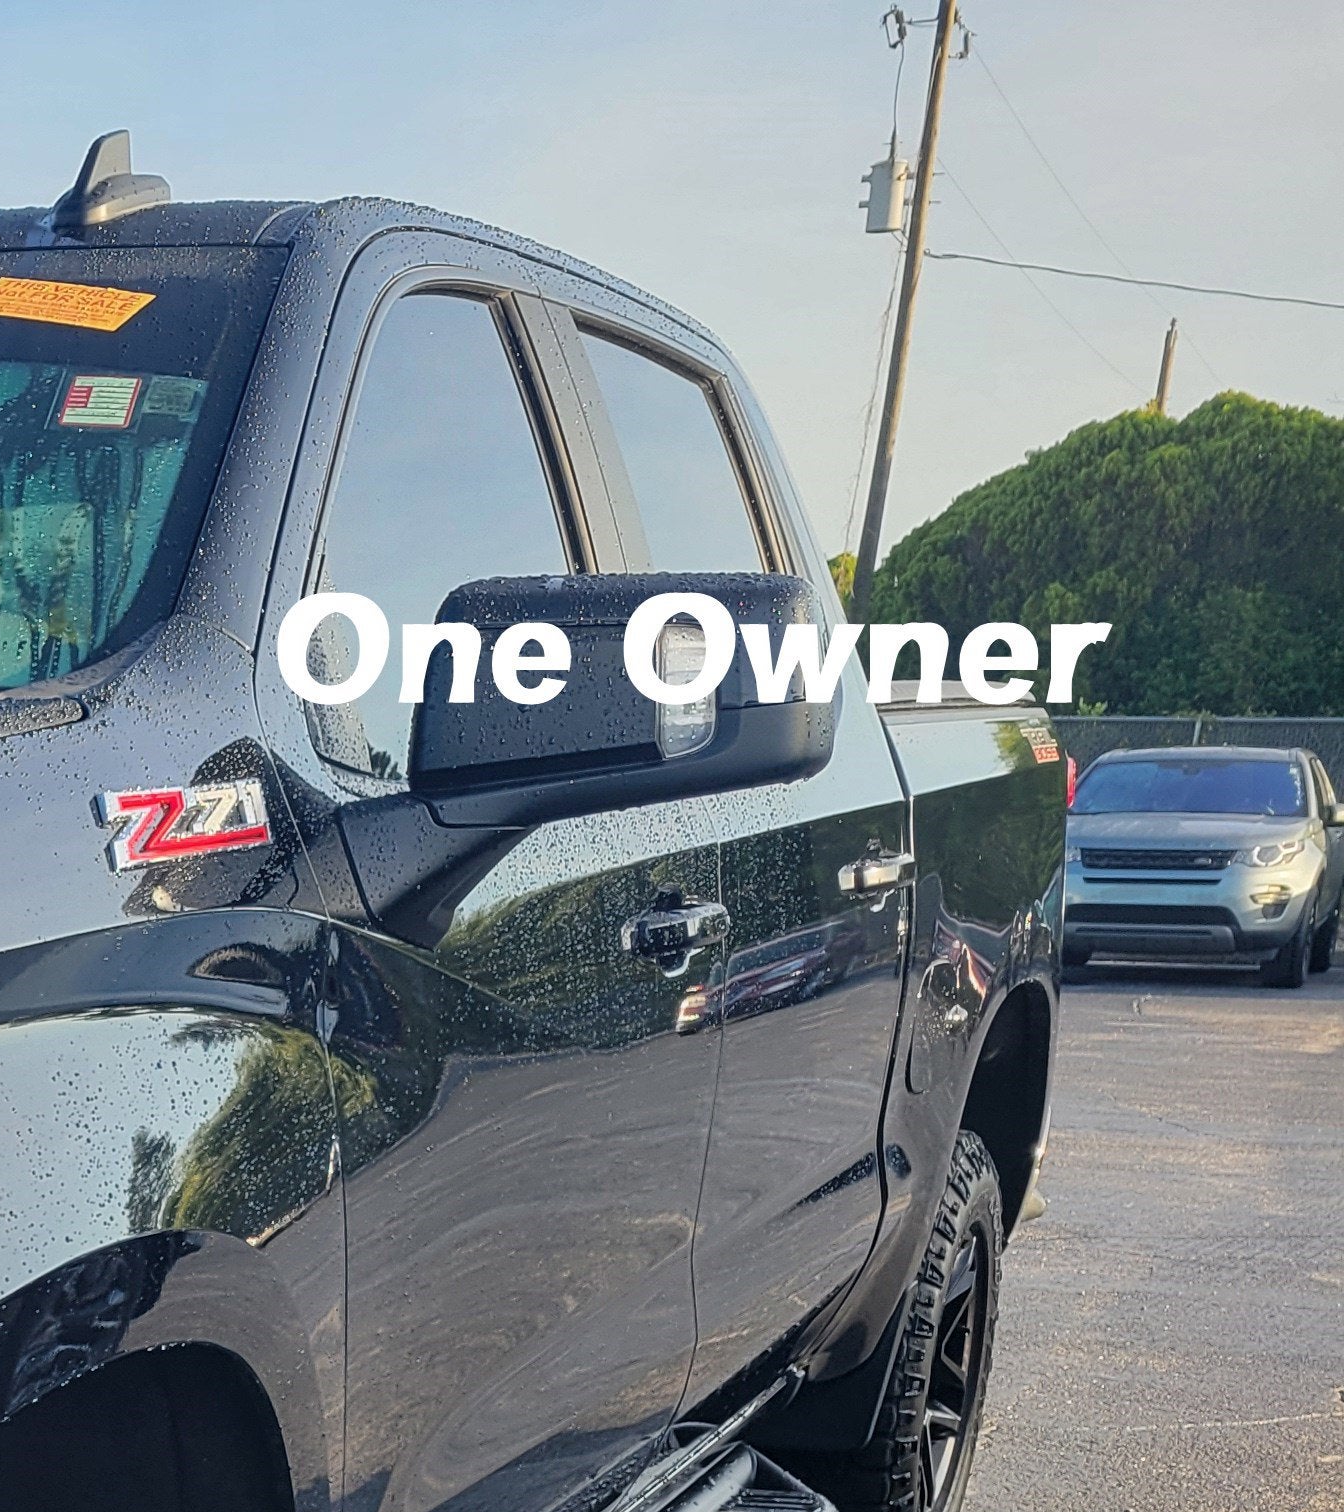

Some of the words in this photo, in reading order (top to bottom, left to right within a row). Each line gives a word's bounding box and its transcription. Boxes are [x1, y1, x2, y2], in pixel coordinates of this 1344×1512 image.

[2, 280, 51, 292] THIS
[53, 284, 143, 301] VEHICLE
[29, 292, 75, 303] FOR
[77, 296, 135, 312] SALE
[90, 778, 272, 873] Z71
